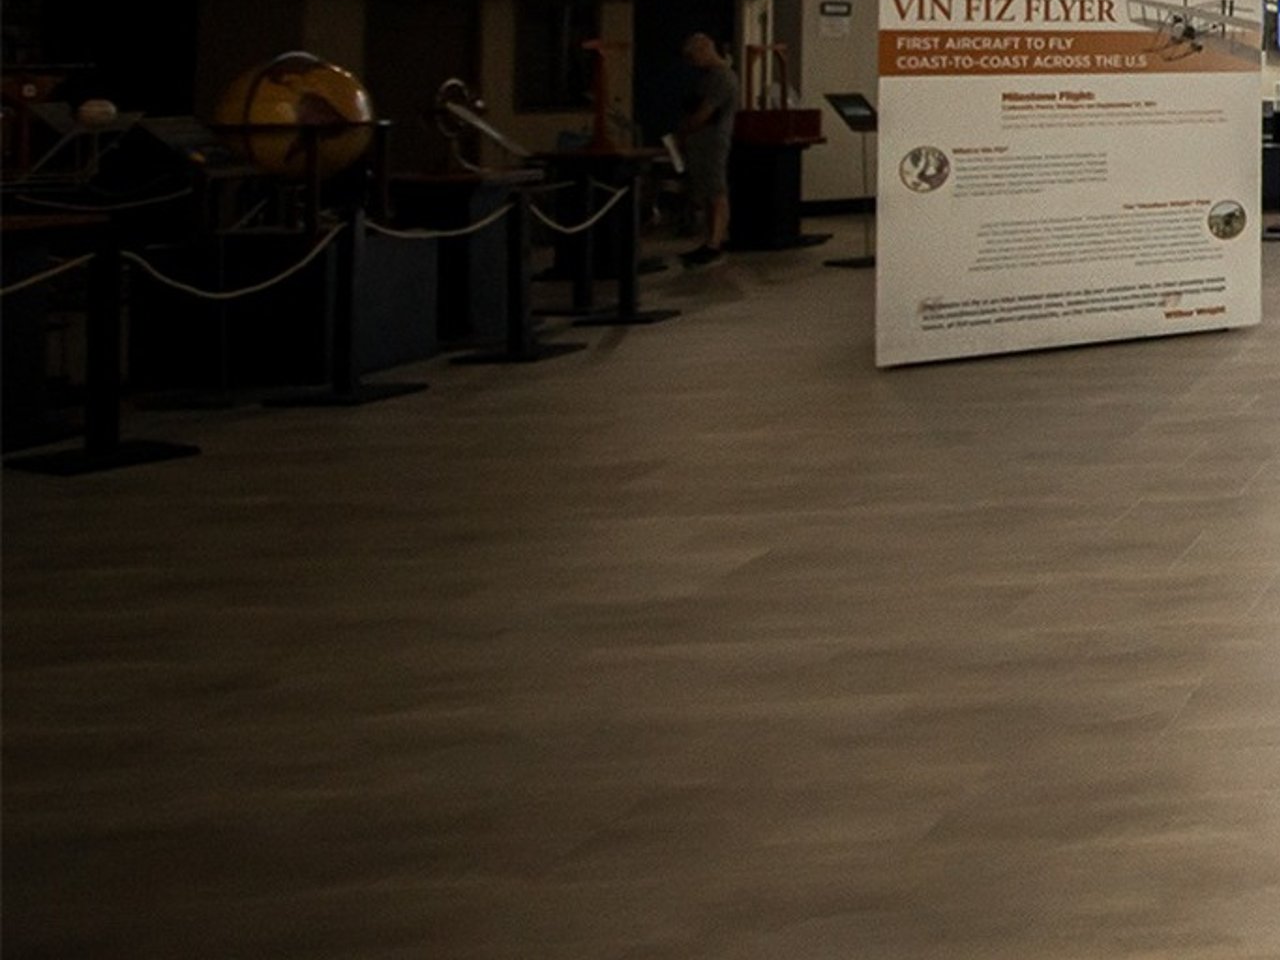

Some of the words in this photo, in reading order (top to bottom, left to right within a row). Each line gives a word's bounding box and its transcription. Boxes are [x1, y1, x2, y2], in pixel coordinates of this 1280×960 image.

[896, 36, 940, 50] FIRST
[945, 36, 1021, 50] AIRCRAFT
[1026, 37, 1046, 50] TO
[1049, 37, 1075, 50] FLY
[896, 54, 1029, 70] COAST-TO-COAST
[1033, 54, 1091, 69] ACROSS
[1096, 54, 1123, 68] THE
